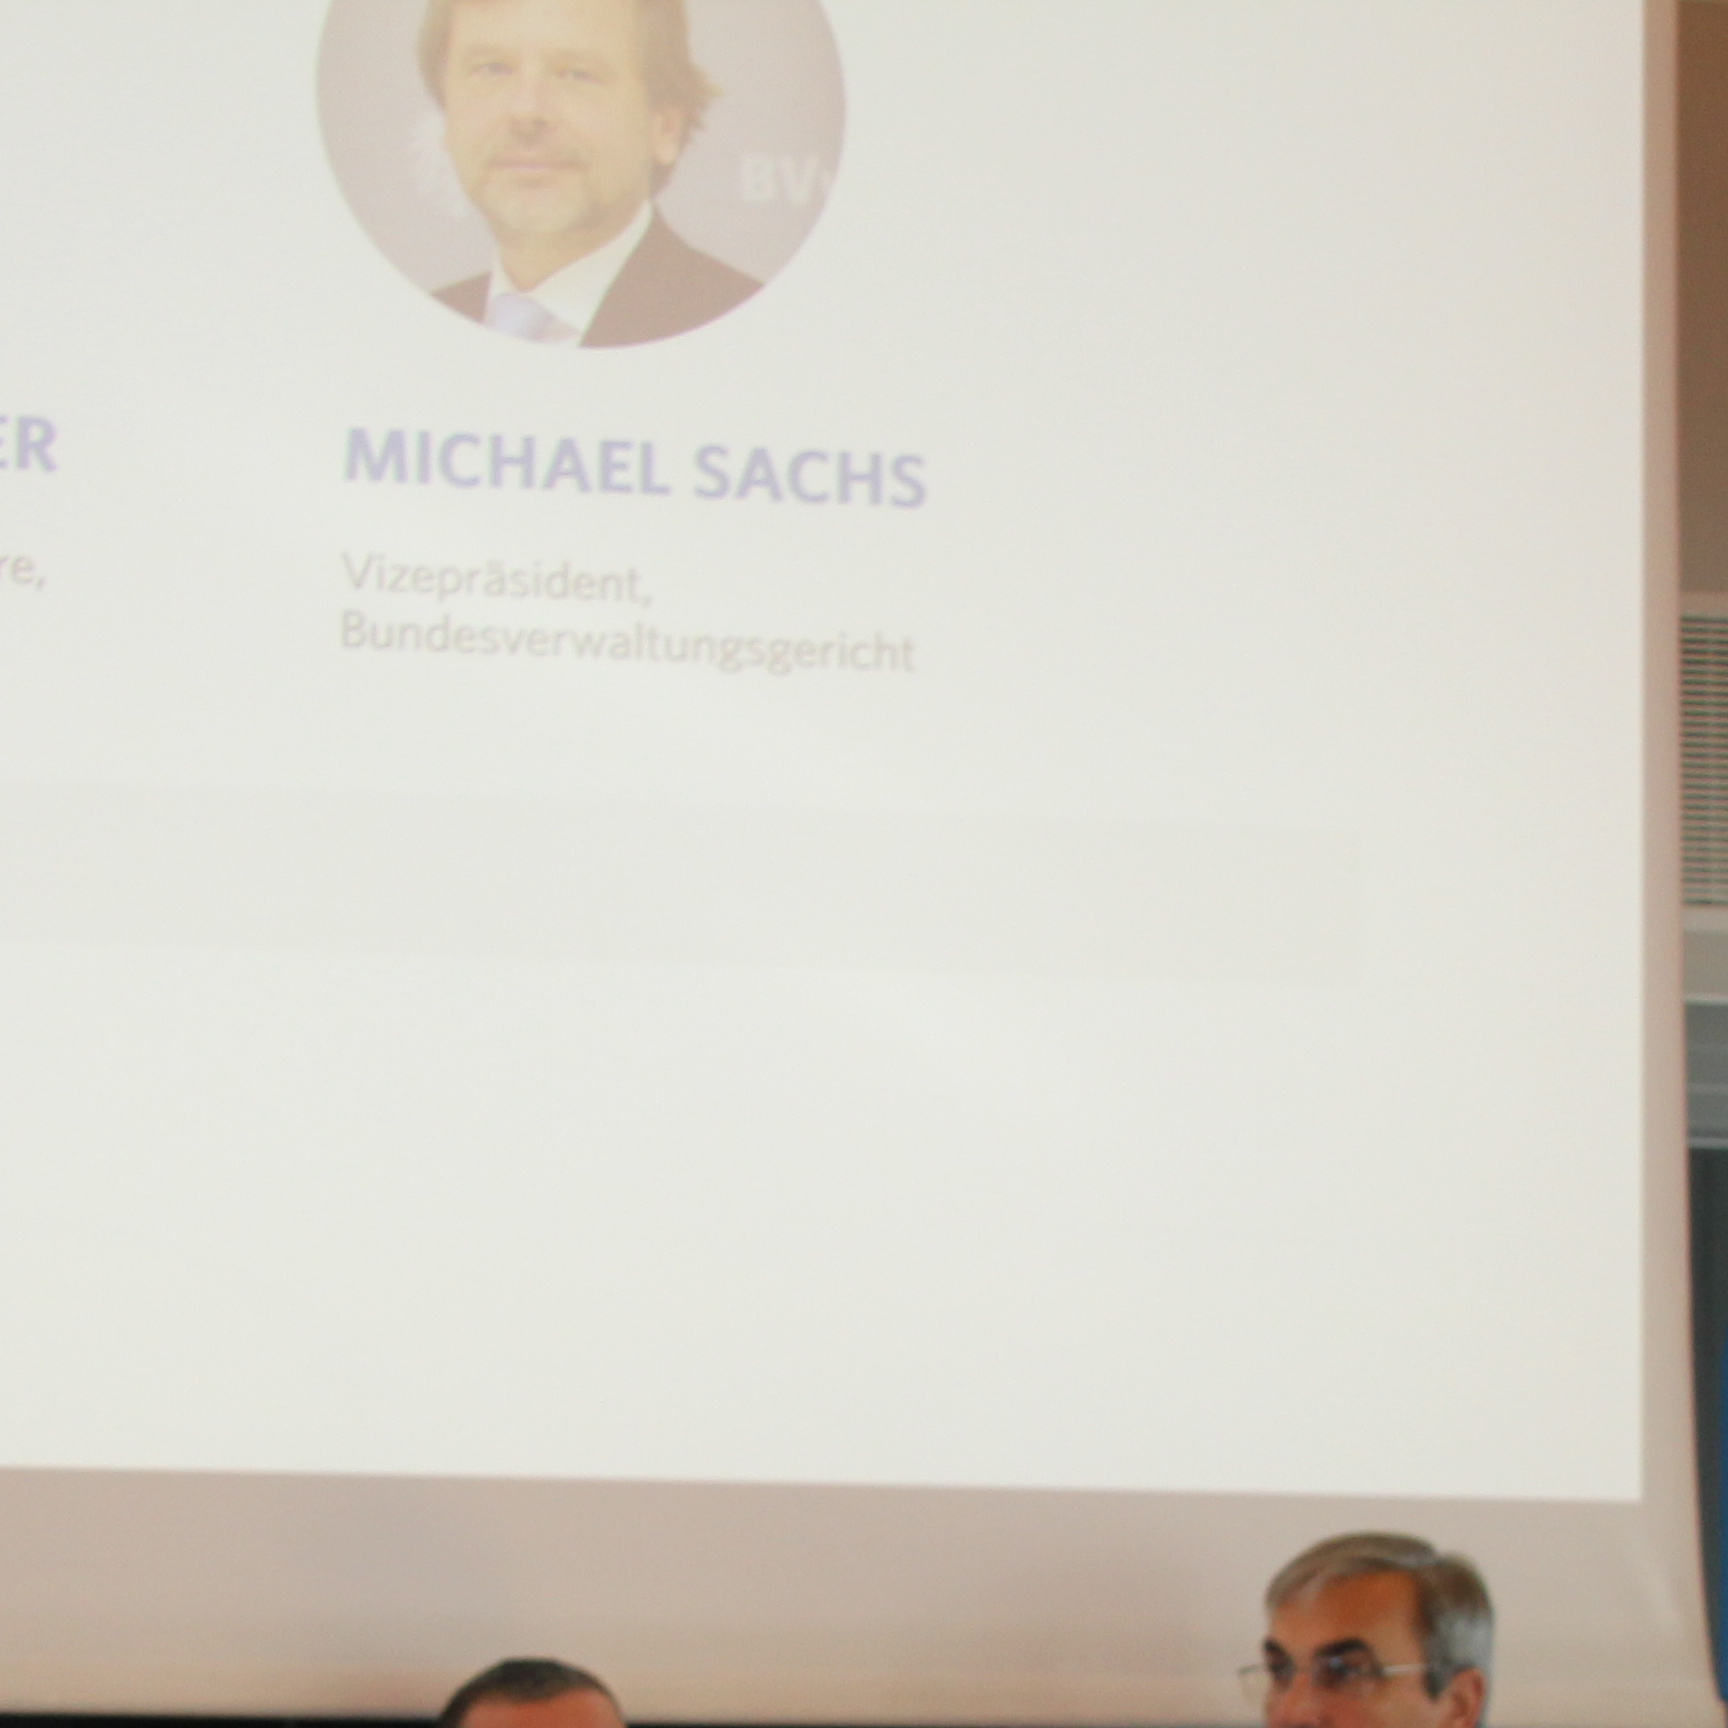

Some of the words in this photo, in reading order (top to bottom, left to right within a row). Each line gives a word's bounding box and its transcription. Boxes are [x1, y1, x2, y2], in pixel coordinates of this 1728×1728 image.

[345, 428, 670, 495] MICHAEL
[695, 444, 926, 508] SACHS
[341, 552, 652, 608] Vizepräsident,
[340, 609, 915, 676] Bundesverwaltungsgericht
